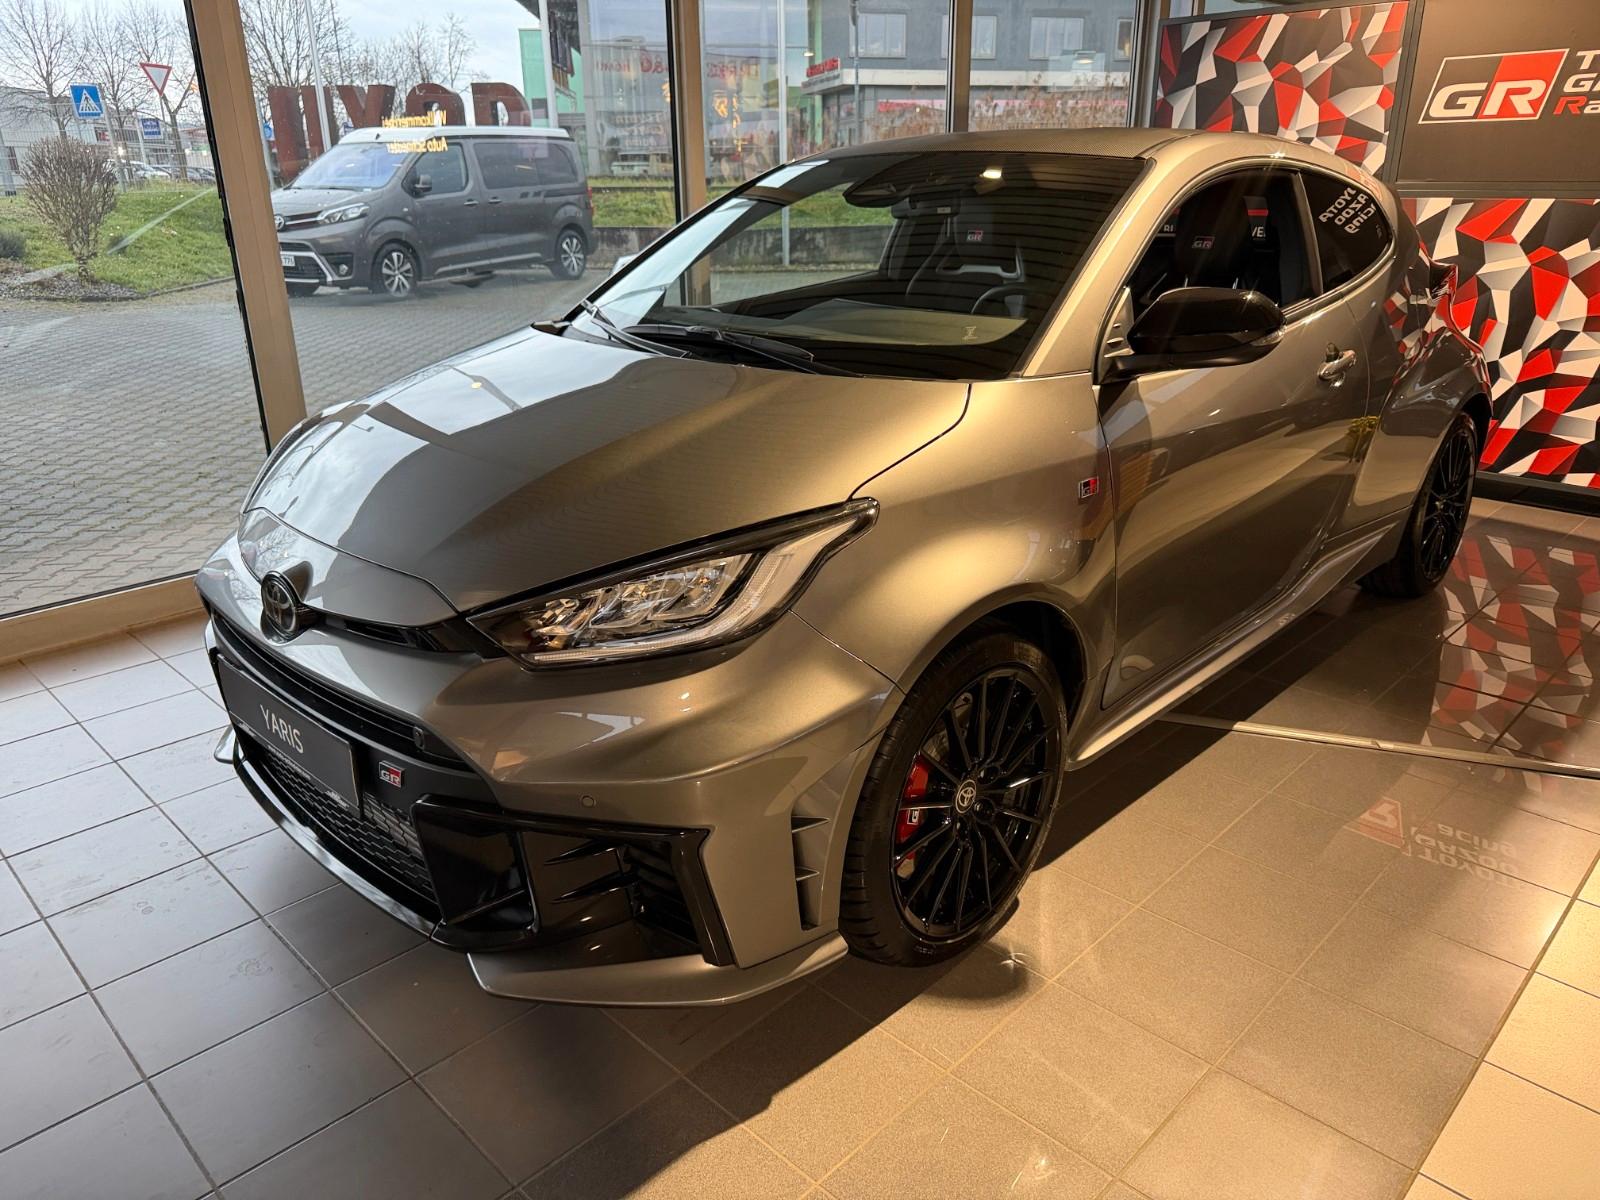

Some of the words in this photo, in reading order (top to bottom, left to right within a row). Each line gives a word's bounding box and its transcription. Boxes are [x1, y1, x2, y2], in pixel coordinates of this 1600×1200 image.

[1576, 50, 1600, 70] T
[1429, 79, 1547, 117] GR
[260, 704, 304, 754] YARIS
